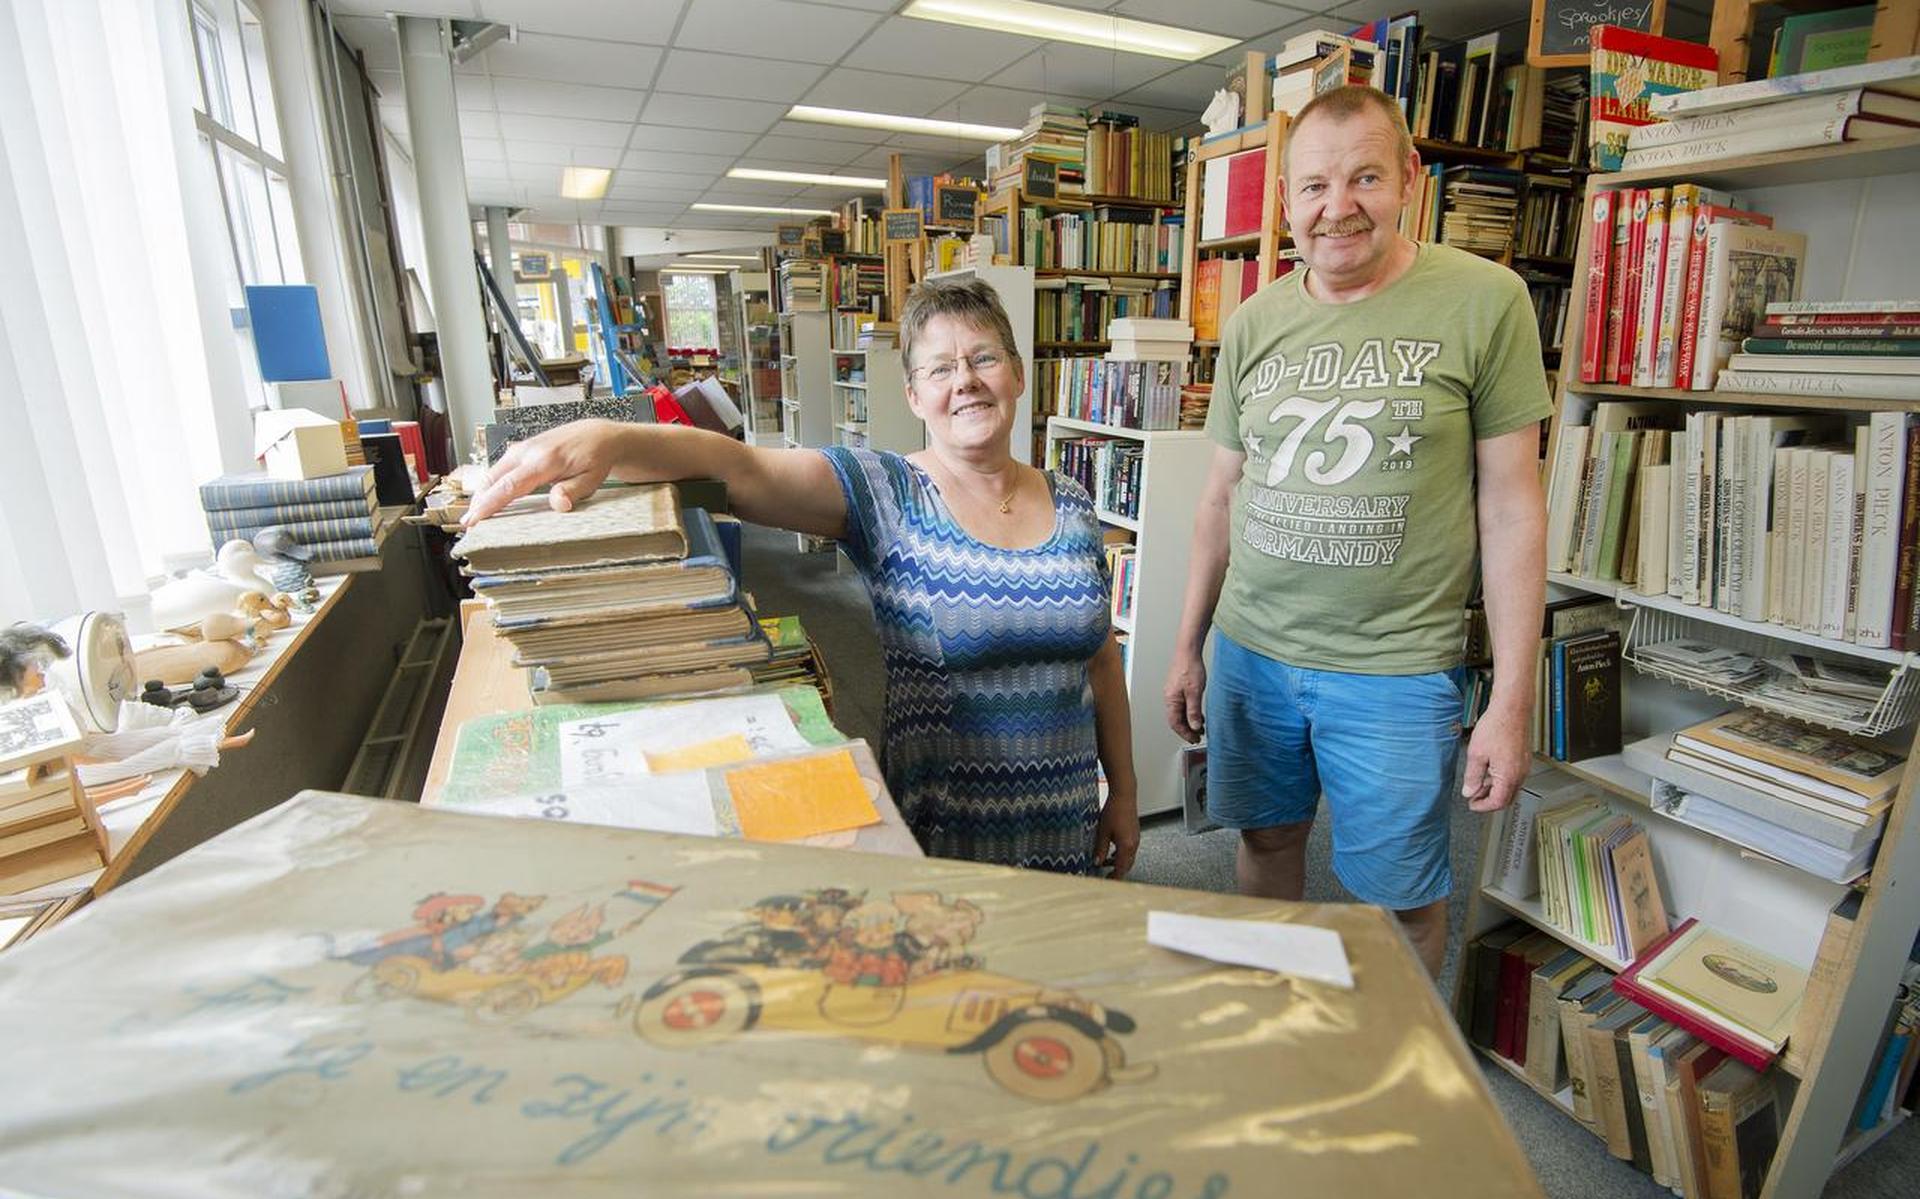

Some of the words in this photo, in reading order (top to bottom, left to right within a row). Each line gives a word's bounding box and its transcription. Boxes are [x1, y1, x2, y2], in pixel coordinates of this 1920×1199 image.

[1639, 121, 1682, 142] ANTON
[1690, 115, 1736, 132] PIECK
[1628, 149, 1674, 166] ANTON
[1682, 139, 1728, 157] PIECK
[1250, 339, 1441, 400] D-DAY
[1722, 375, 1777, 389] ANTON
[1788, 377, 1844, 393] PIECK
[1266, 395, 1387, 487] 75
[1391, 399, 1423, 418] TH
[1876, 423, 1896, 477] ANTON
[1381, 460, 1413, 471] 2019
[1812, 468, 1825, 506] ANTON
[1834, 466, 1847, 505] ANTON
[1319, 522, 1384, 535] LANDING
[1811, 511, 1823, 545] PIECK
[1831, 510, 1845, 543] PIECK
[1871, 488, 1890, 536] PIECK
